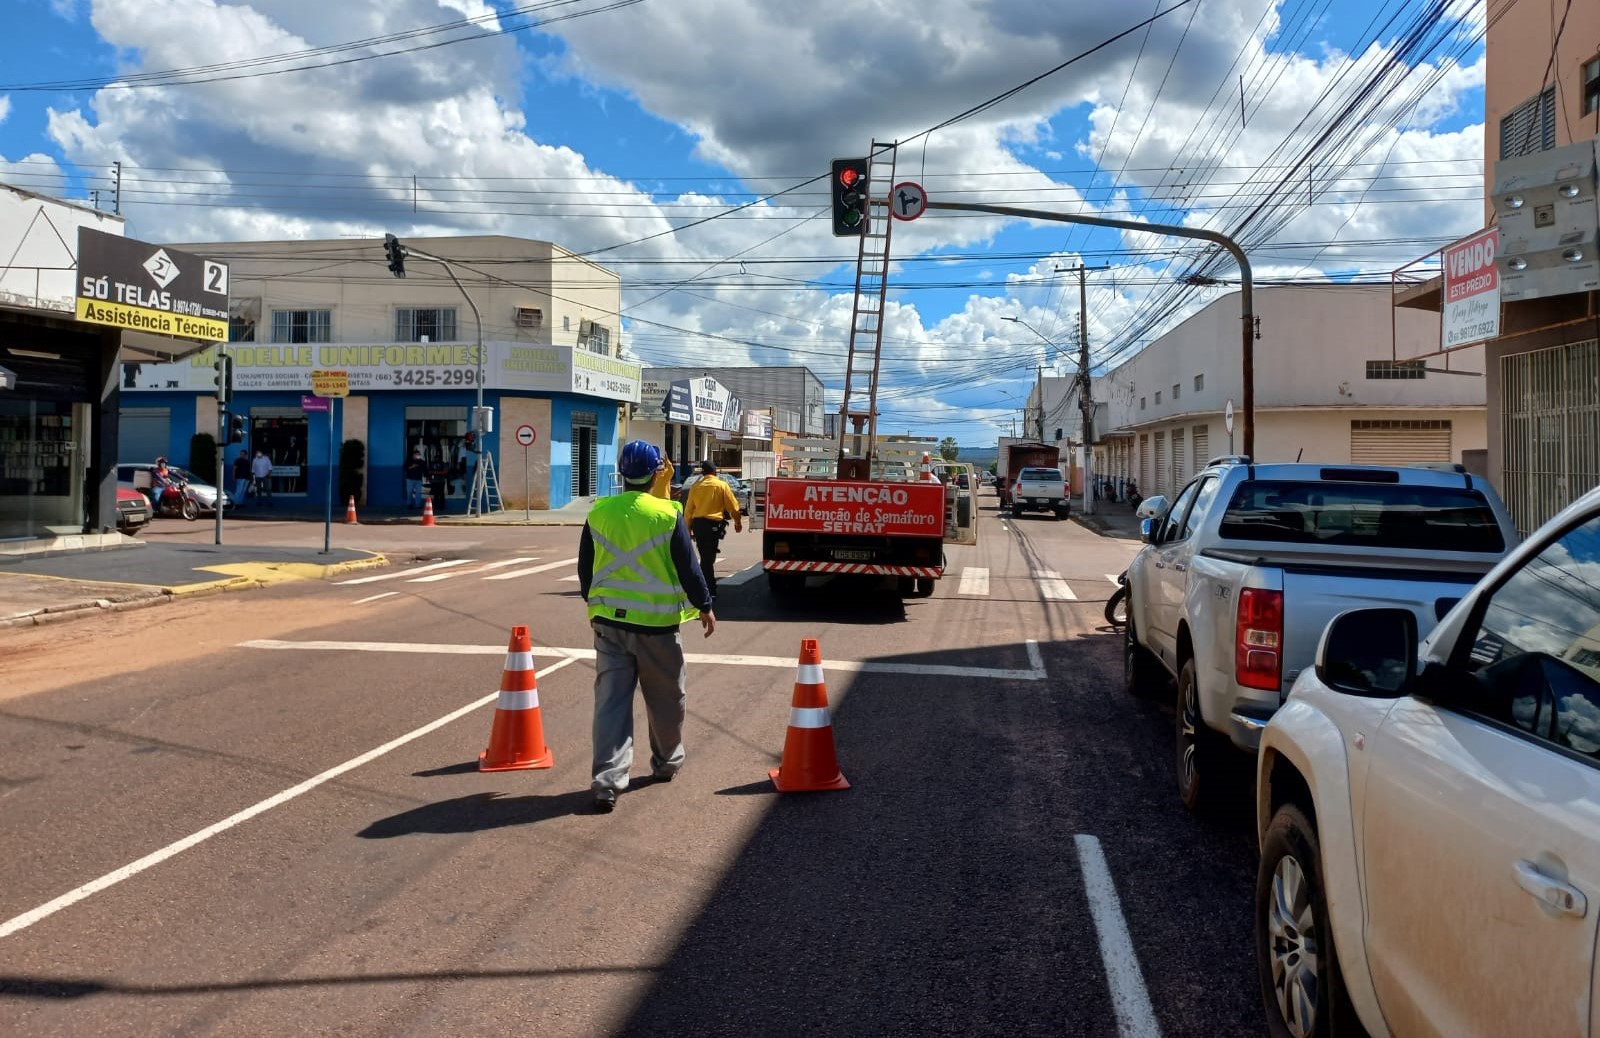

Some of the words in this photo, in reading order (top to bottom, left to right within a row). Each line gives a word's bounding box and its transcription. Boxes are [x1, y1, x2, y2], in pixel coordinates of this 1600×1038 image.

[1449, 237, 1495, 280] VENDO
[208, 265, 222, 292] 2
[1451, 283, 1466, 298] ESTE
[1466, 273, 1492, 294] PRÉDIO
[82, 275, 109, 300] SÓ
[114, 282, 171, 311] TELAS
[84, 302, 171, 332] Assistência
[174, 317, 224, 339] Técnica
[191, 346, 313, 368] MDELLE
[319, 345, 488, 367] UNIFORMES
[393, 369, 486, 386] 3425-2996
[704, 378, 717, 392] CASA
[695, 395, 723, 413] PARAFUSOS
[803, 485, 908, 505] ATENÇÃO
[768, 503, 851, 522] Manutenção
[855, 507, 870, 521] de
[873, 508, 935, 525] Semáforo
[822, 521, 886, 534] SETRAT
